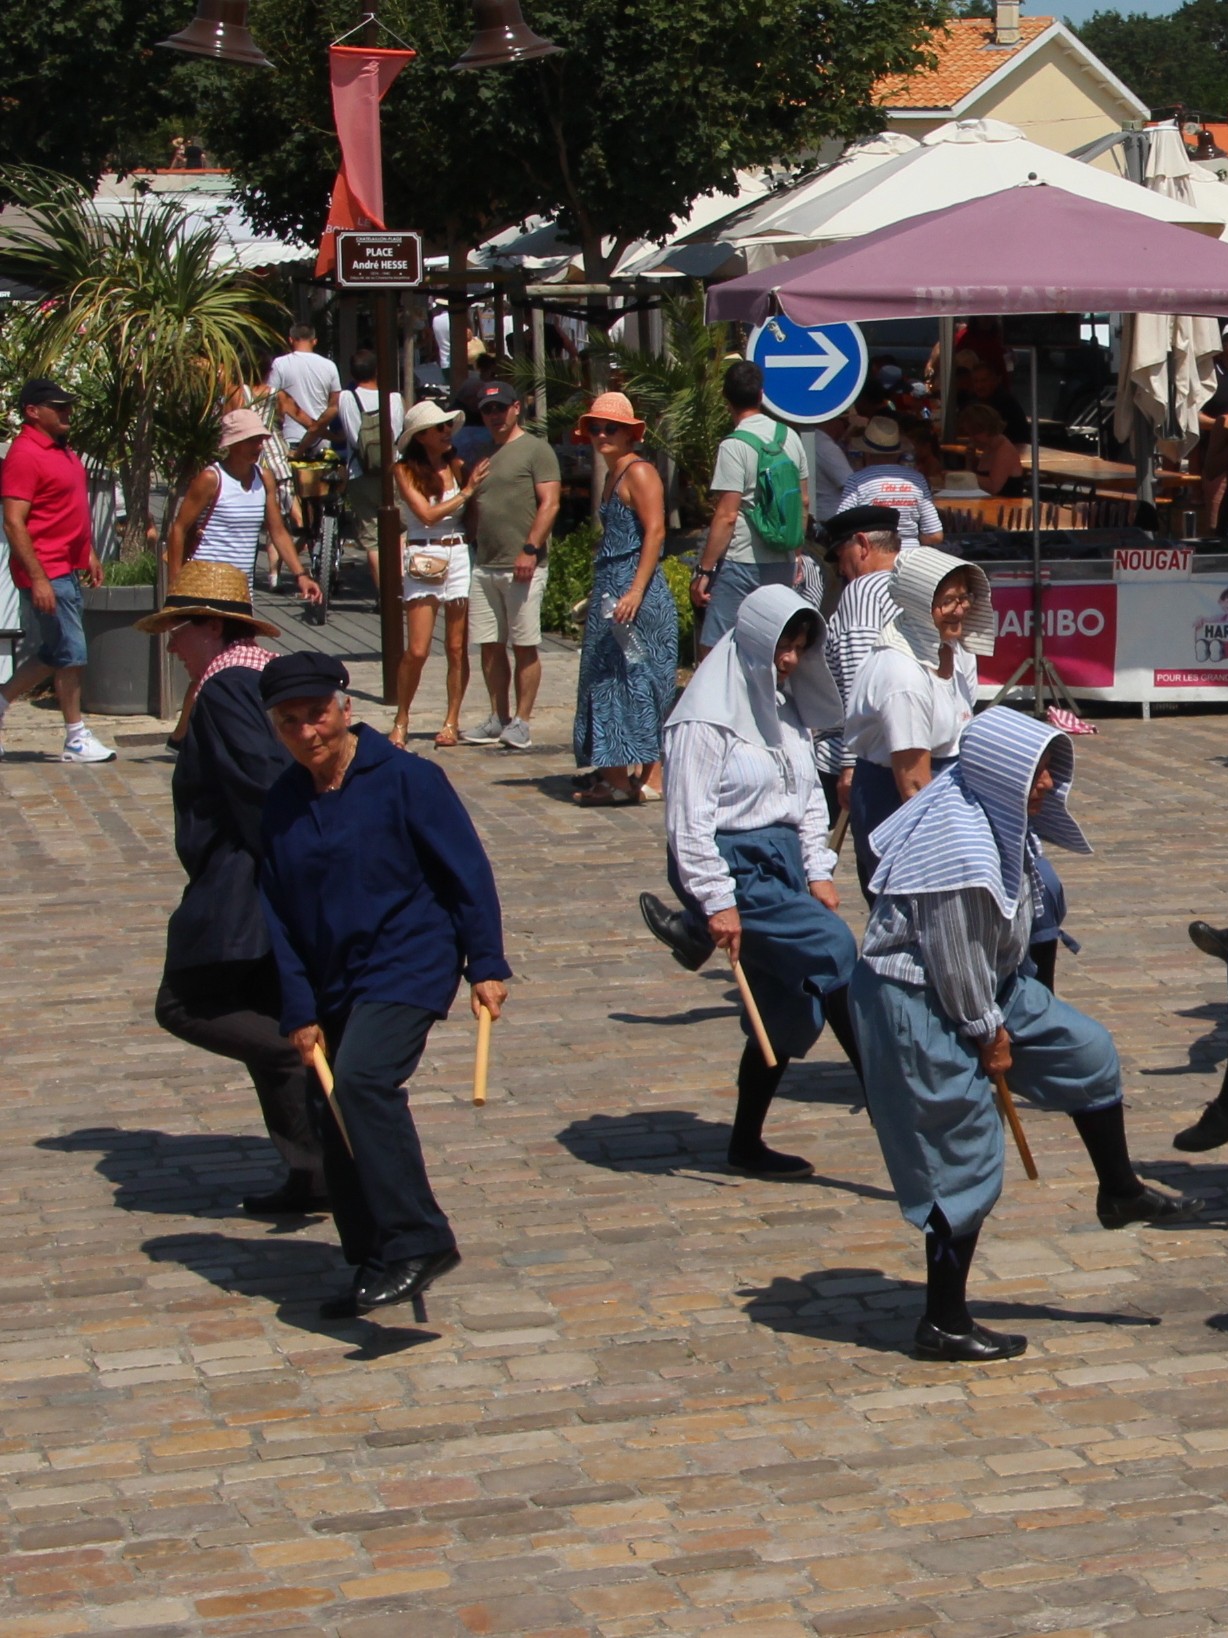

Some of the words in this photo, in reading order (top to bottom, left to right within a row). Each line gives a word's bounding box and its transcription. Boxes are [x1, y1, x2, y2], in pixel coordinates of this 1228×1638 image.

[366, 248, 393, 257] PLACE
[352, 260, 379, 269] André
[381, 261, 408, 269] HESSE
[1116, 550, 1191, 570] NOUGAT
[1157, 674, 1181, 682] POUR
[1183, 674, 1198, 682] LES
